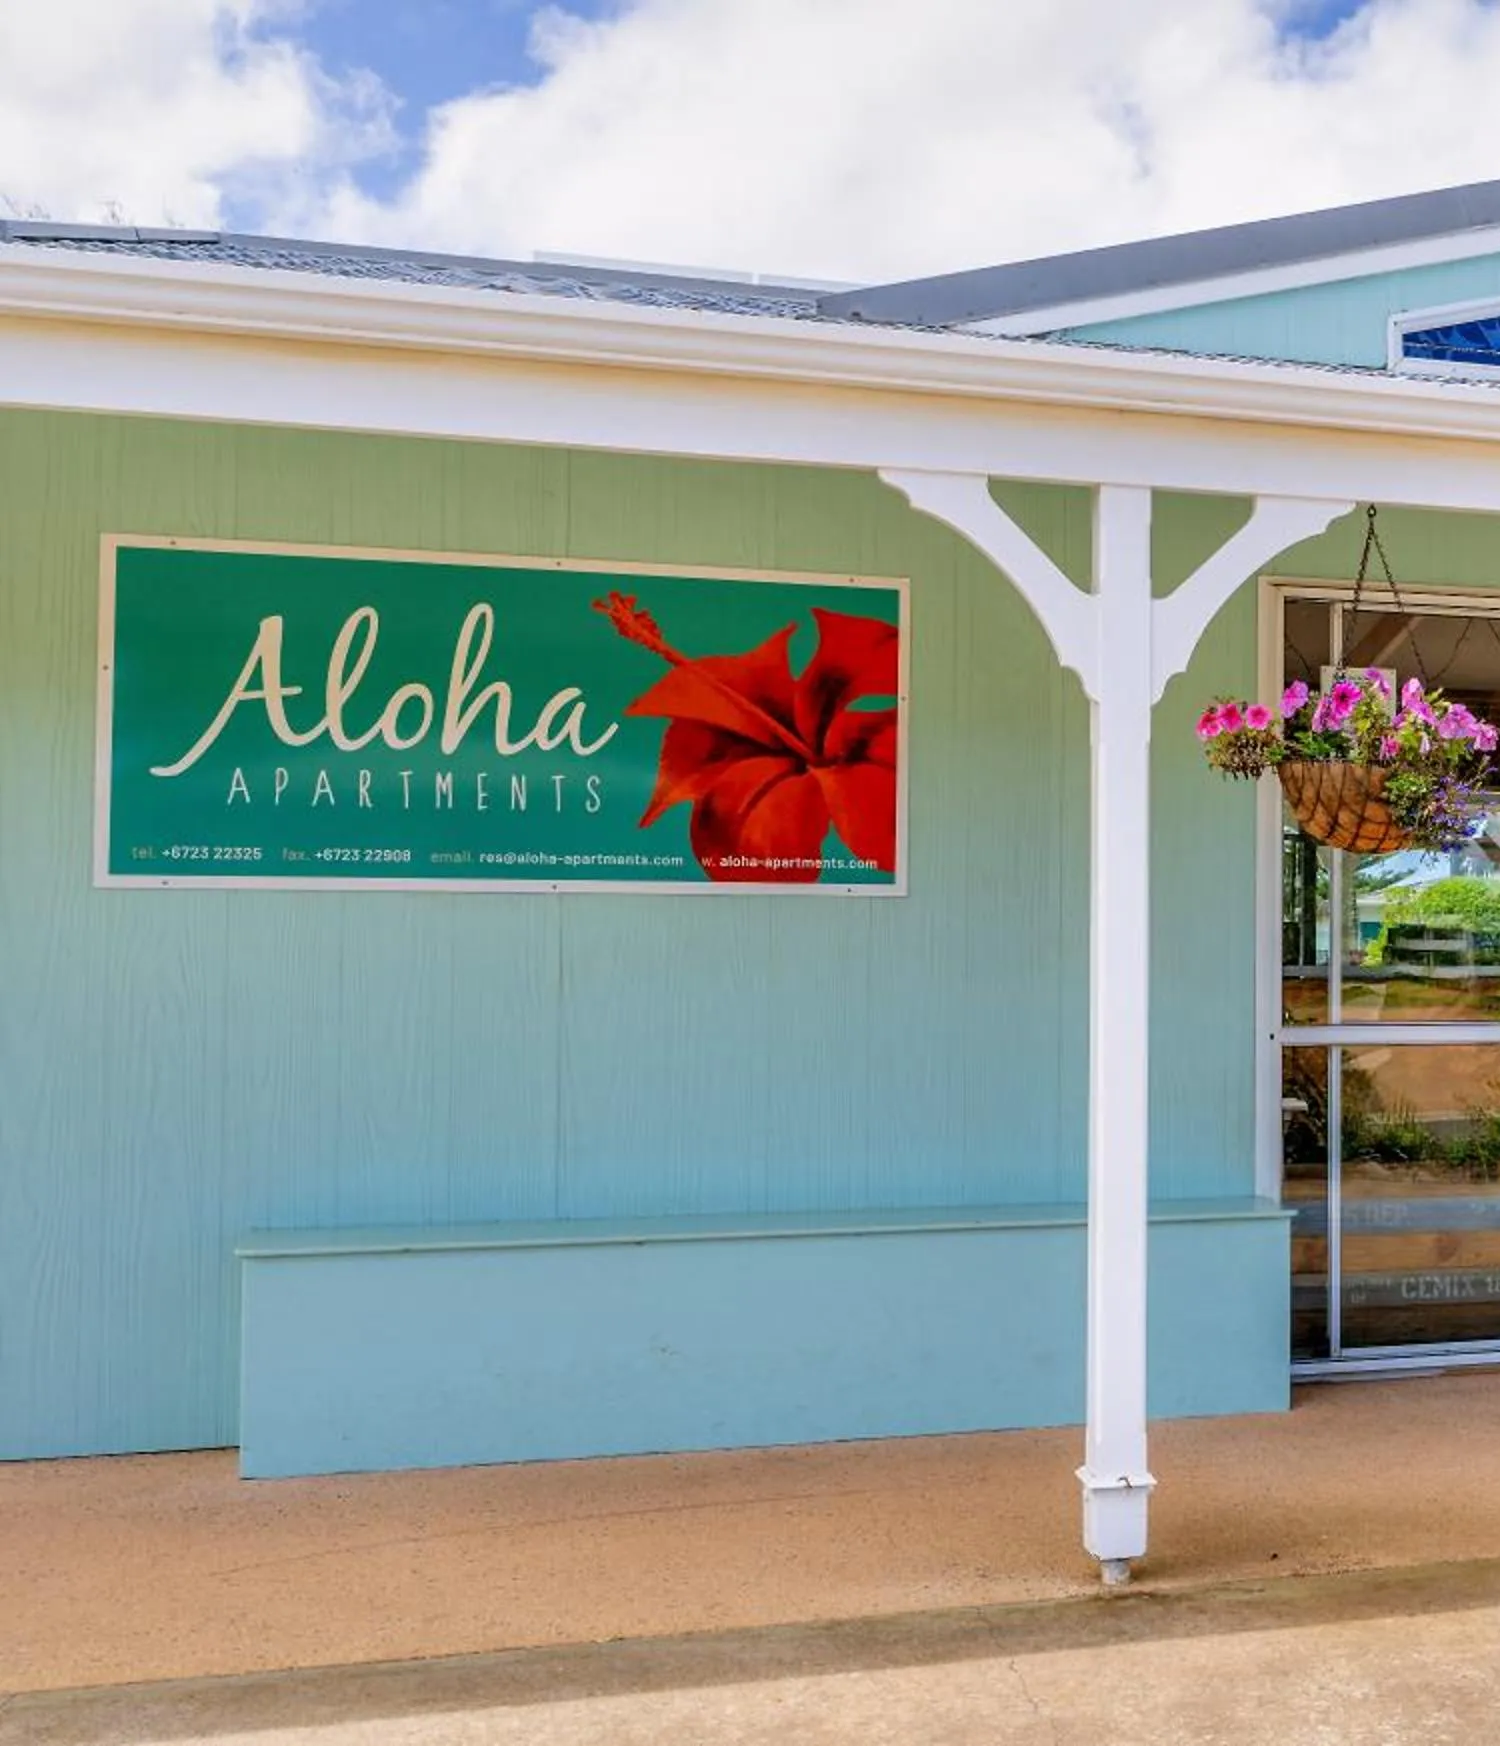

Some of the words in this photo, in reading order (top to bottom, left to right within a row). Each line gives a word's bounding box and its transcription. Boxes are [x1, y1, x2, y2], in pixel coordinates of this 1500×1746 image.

[150, 602, 619, 777] Aloha
[226, 766, 602, 814] APARTMENTS
[161, 847, 209, 860] +6723
[213, 847, 263, 861] 22325
[314, 848, 360, 862] +6723
[478, 851, 684, 868] res@aloha-apartments.com
[701, 856, 717, 867] w.
[718, 853, 879, 871] aloha-apartments.com
